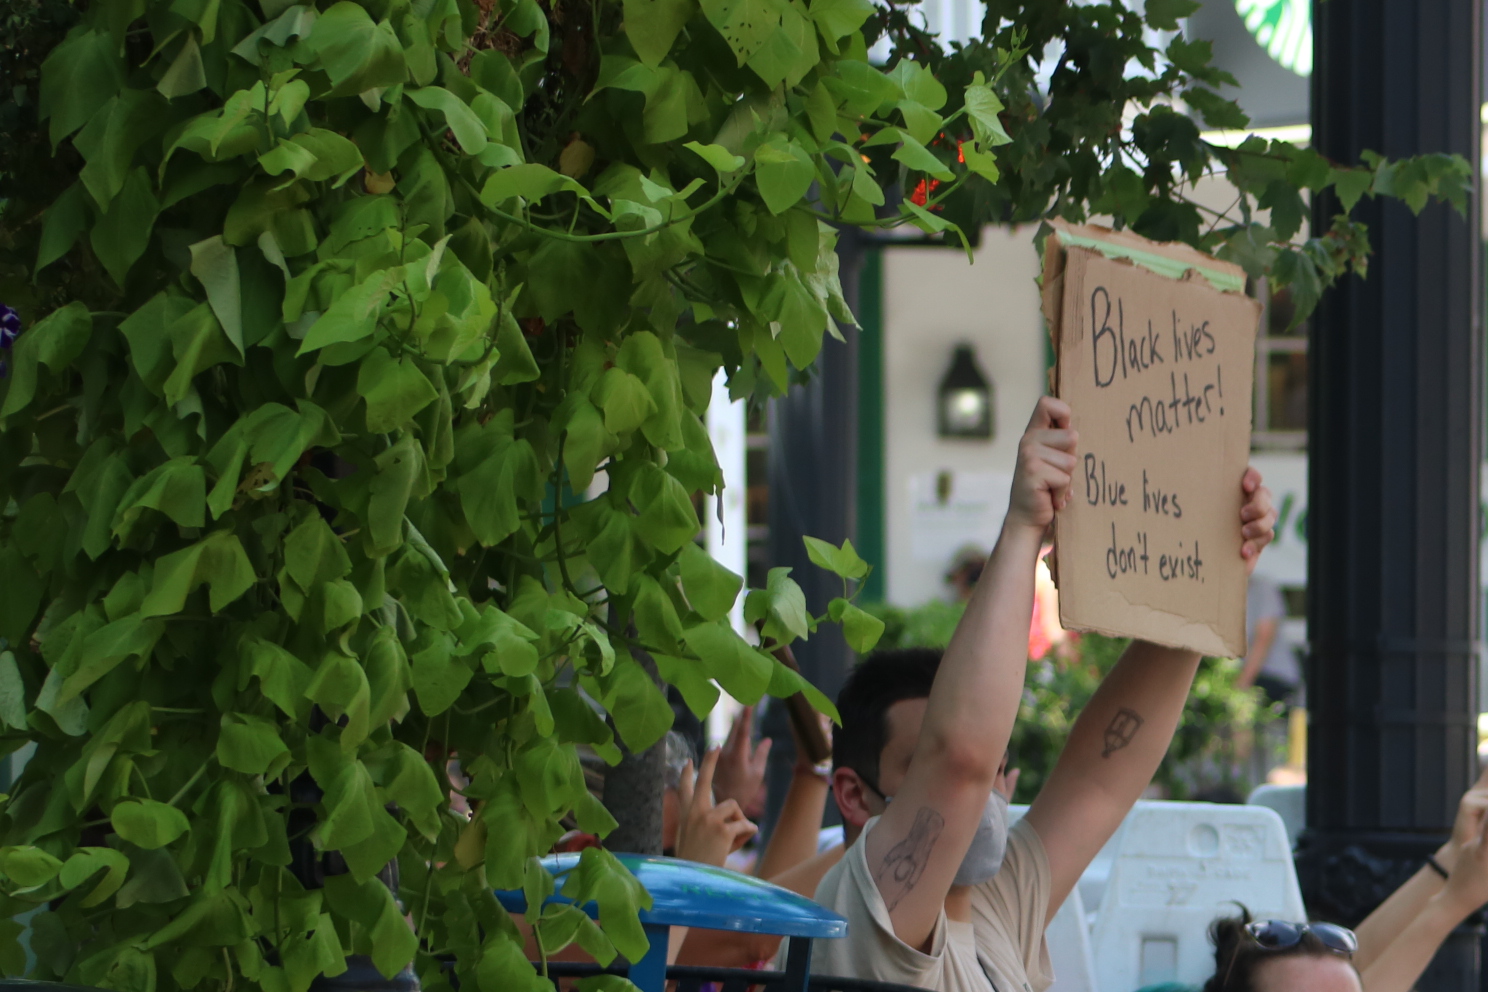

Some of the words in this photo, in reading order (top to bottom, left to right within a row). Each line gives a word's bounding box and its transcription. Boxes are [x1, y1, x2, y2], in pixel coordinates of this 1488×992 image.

[1091, 286, 1163, 387] Black
[1173, 310, 1215, 363] lives
[1127, 365, 1225, 443] matter!
[1085, 453, 1128, 506] Blue
[1143, 469, 1182, 518] lives
[1107, 523, 1149, 579] don't
